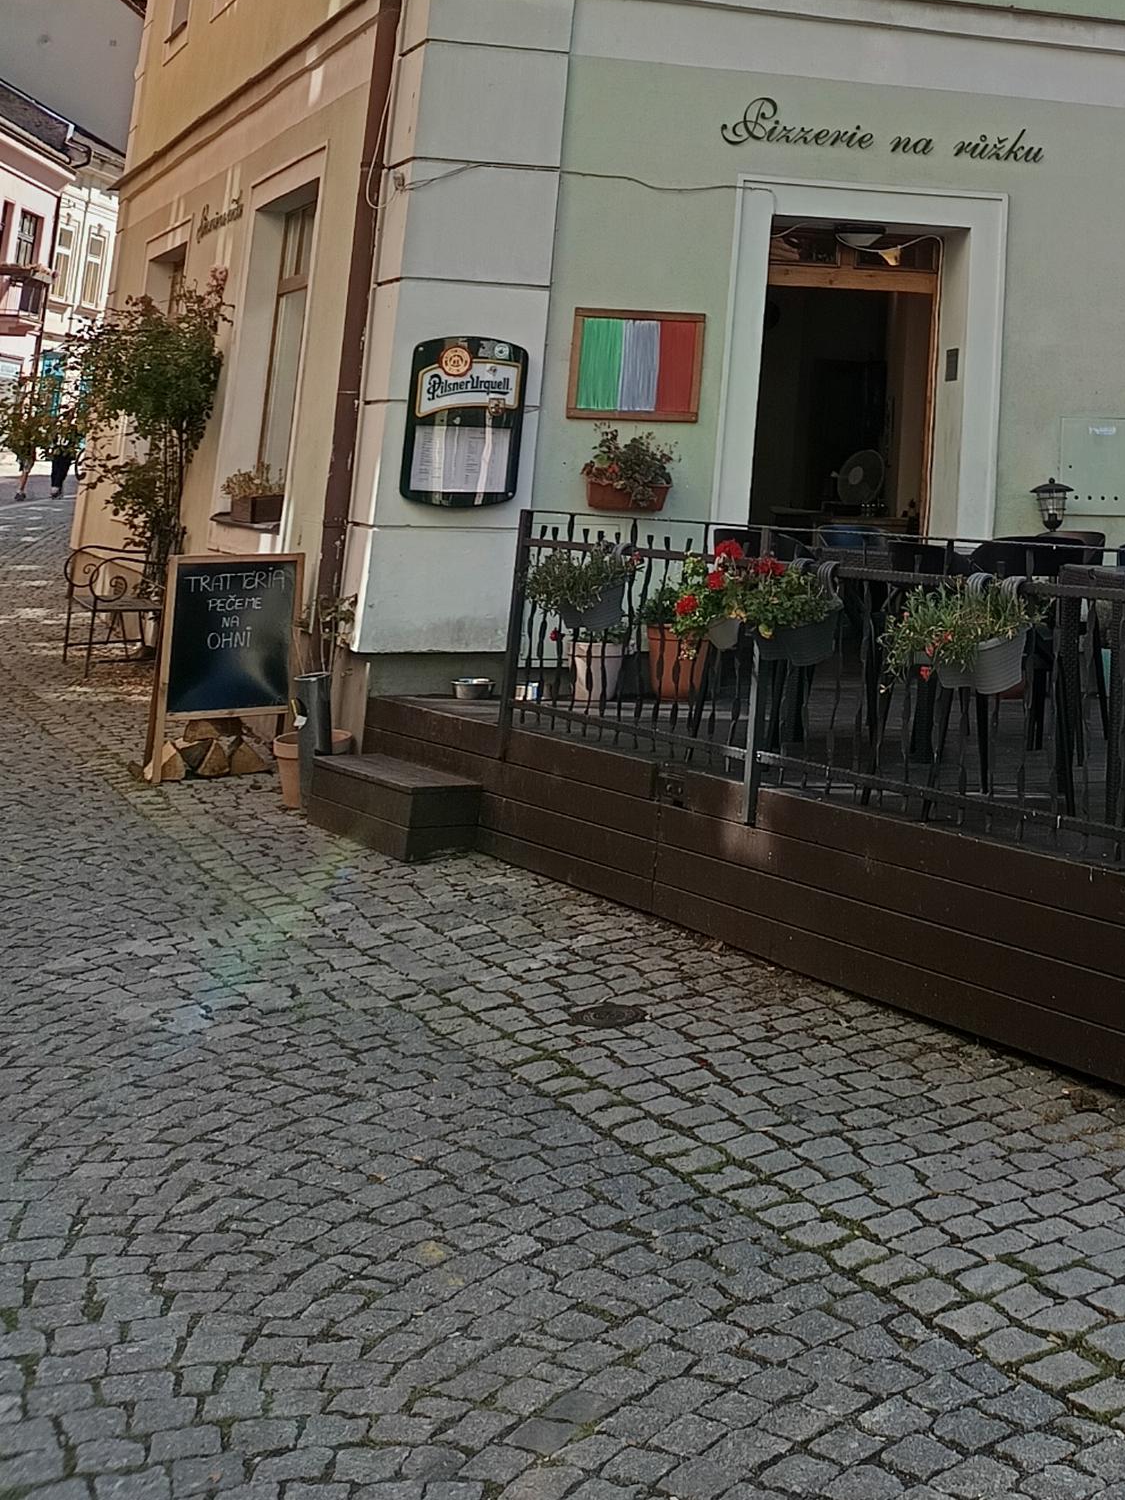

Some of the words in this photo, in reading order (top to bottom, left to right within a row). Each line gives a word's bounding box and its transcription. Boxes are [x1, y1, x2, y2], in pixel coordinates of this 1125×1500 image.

[721, 97, 874, 149] Pizzerie
[890, 132, 935, 155] na
[953, 129, 1045, 164] růžku
[427, 373, 470, 401] Pilsner
[470, 375, 510, 395] Urquell
[207, 594, 262, 612] PEČEME
[221, 615, 240, 628] NA
